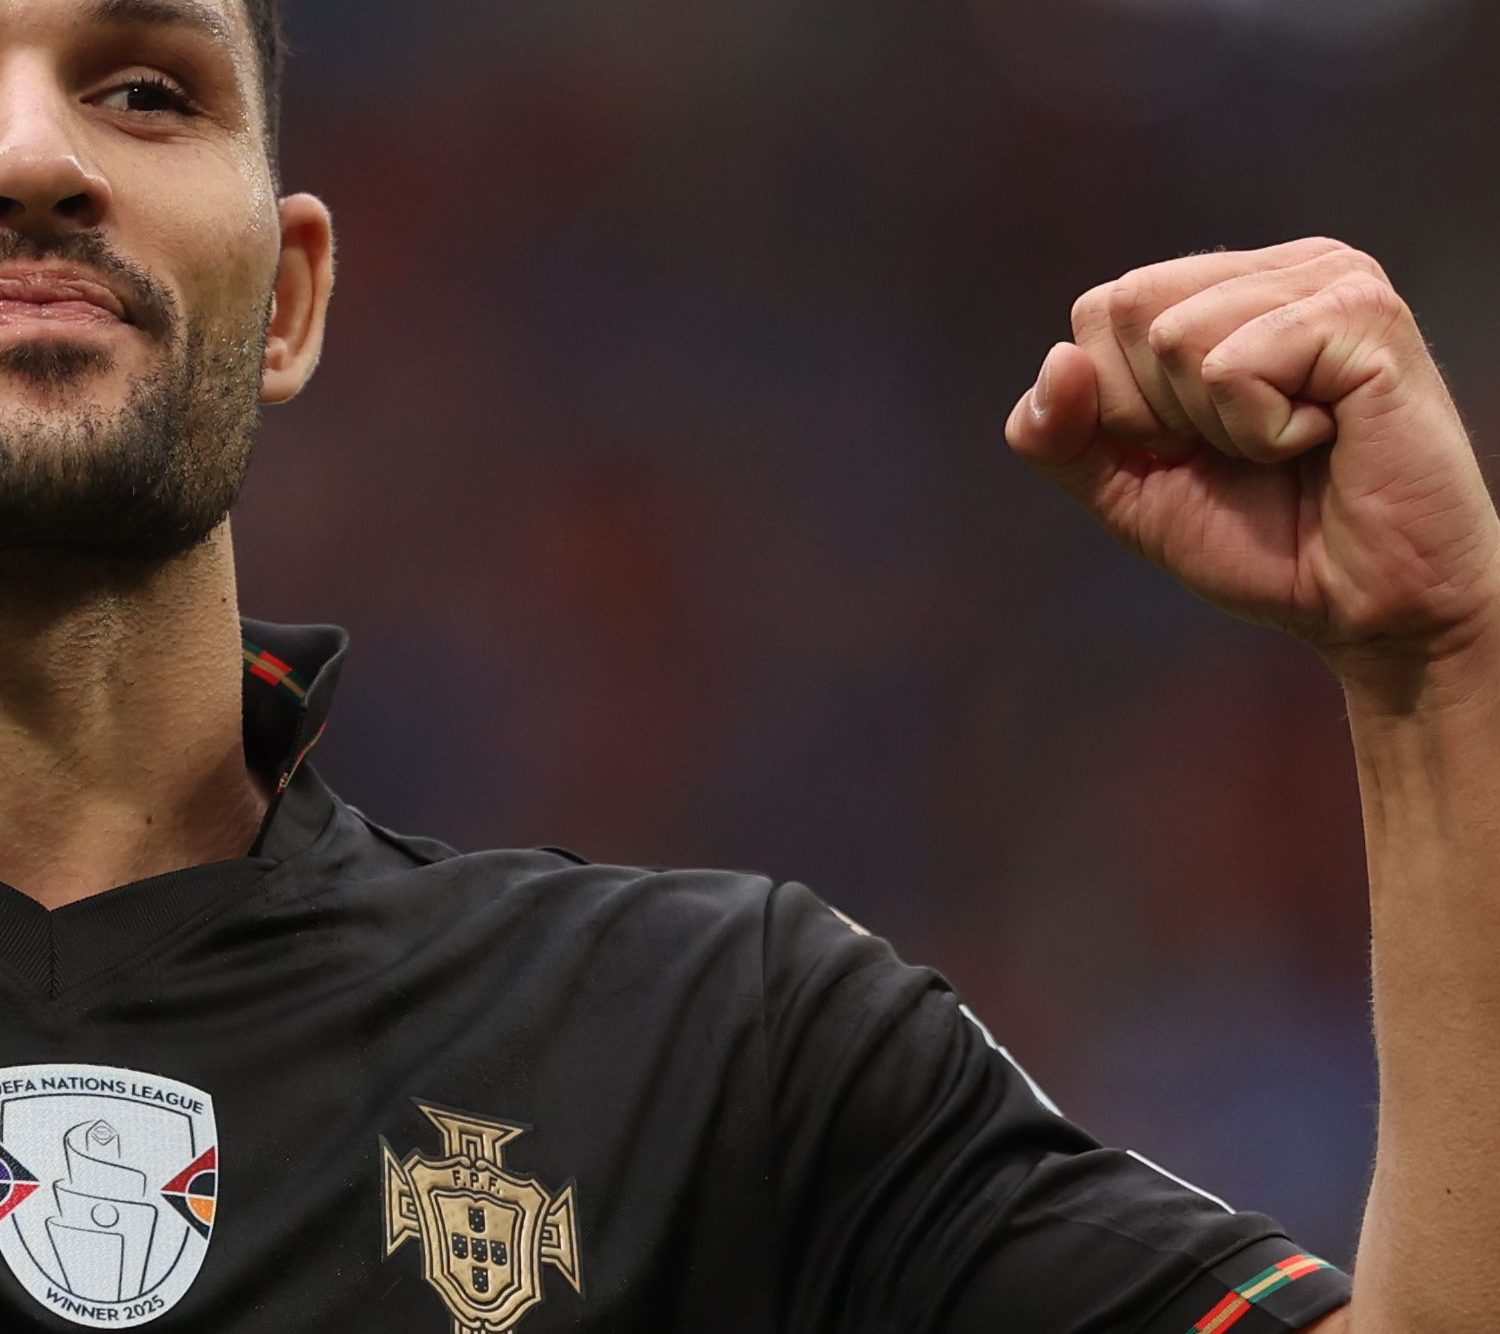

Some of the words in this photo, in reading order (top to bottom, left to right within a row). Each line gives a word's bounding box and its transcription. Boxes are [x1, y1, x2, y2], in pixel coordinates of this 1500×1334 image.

[41, 1077, 127, 1095] NATIONS
[131, 1083, 204, 1115] LEAGUE
[452, 1169, 501, 1195] F.P.F.
[46, 1287, 119, 1321] WINNER
[123, 1294, 166, 1319] 2025
